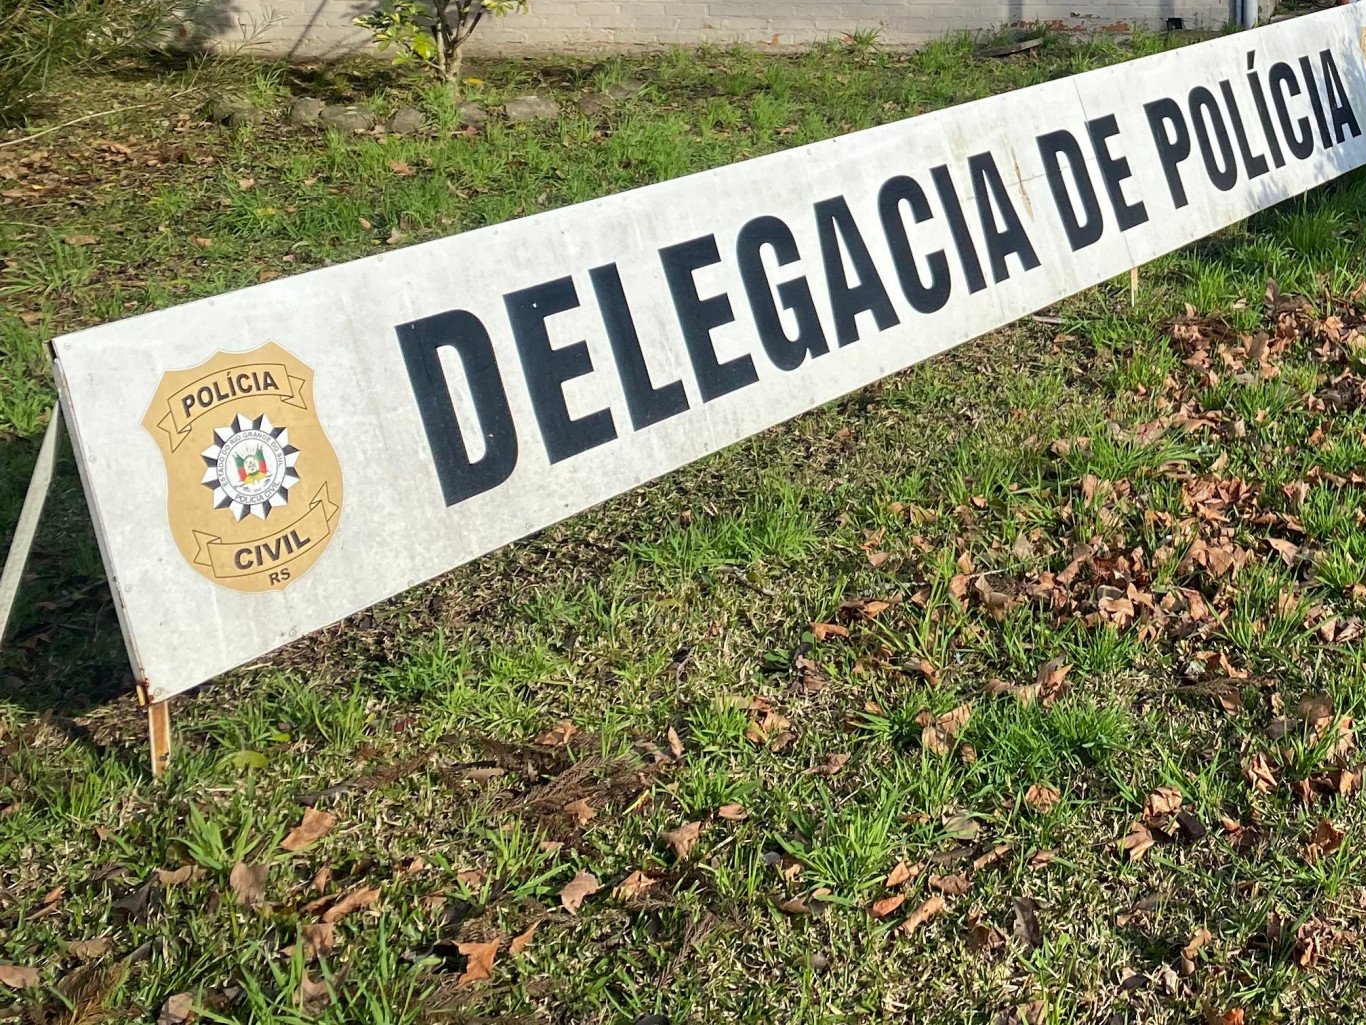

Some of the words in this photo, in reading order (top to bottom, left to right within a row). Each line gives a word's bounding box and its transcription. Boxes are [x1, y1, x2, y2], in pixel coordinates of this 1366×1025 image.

[394, 151, 1042, 508] DELEGACIA
[1035, 113, 1149, 253] DE
[1143, 49, 1362, 210] POLÍCIA
[181, 371, 280, 418] POLÍCIA
[229, 435, 241, 445] RIO
[242, 432, 271, 443] GRANDE
[221, 444, 231, 455] DO
[270, 441, 279, 451] DO
[276, 452, 284, 467] SUL
[218, 456, 228, 487] ESTADO
[264, 481, 280, 497] CIVIL
[233, 529, 311, 570] CIVIL
[268, 567, 291, 586] RS
